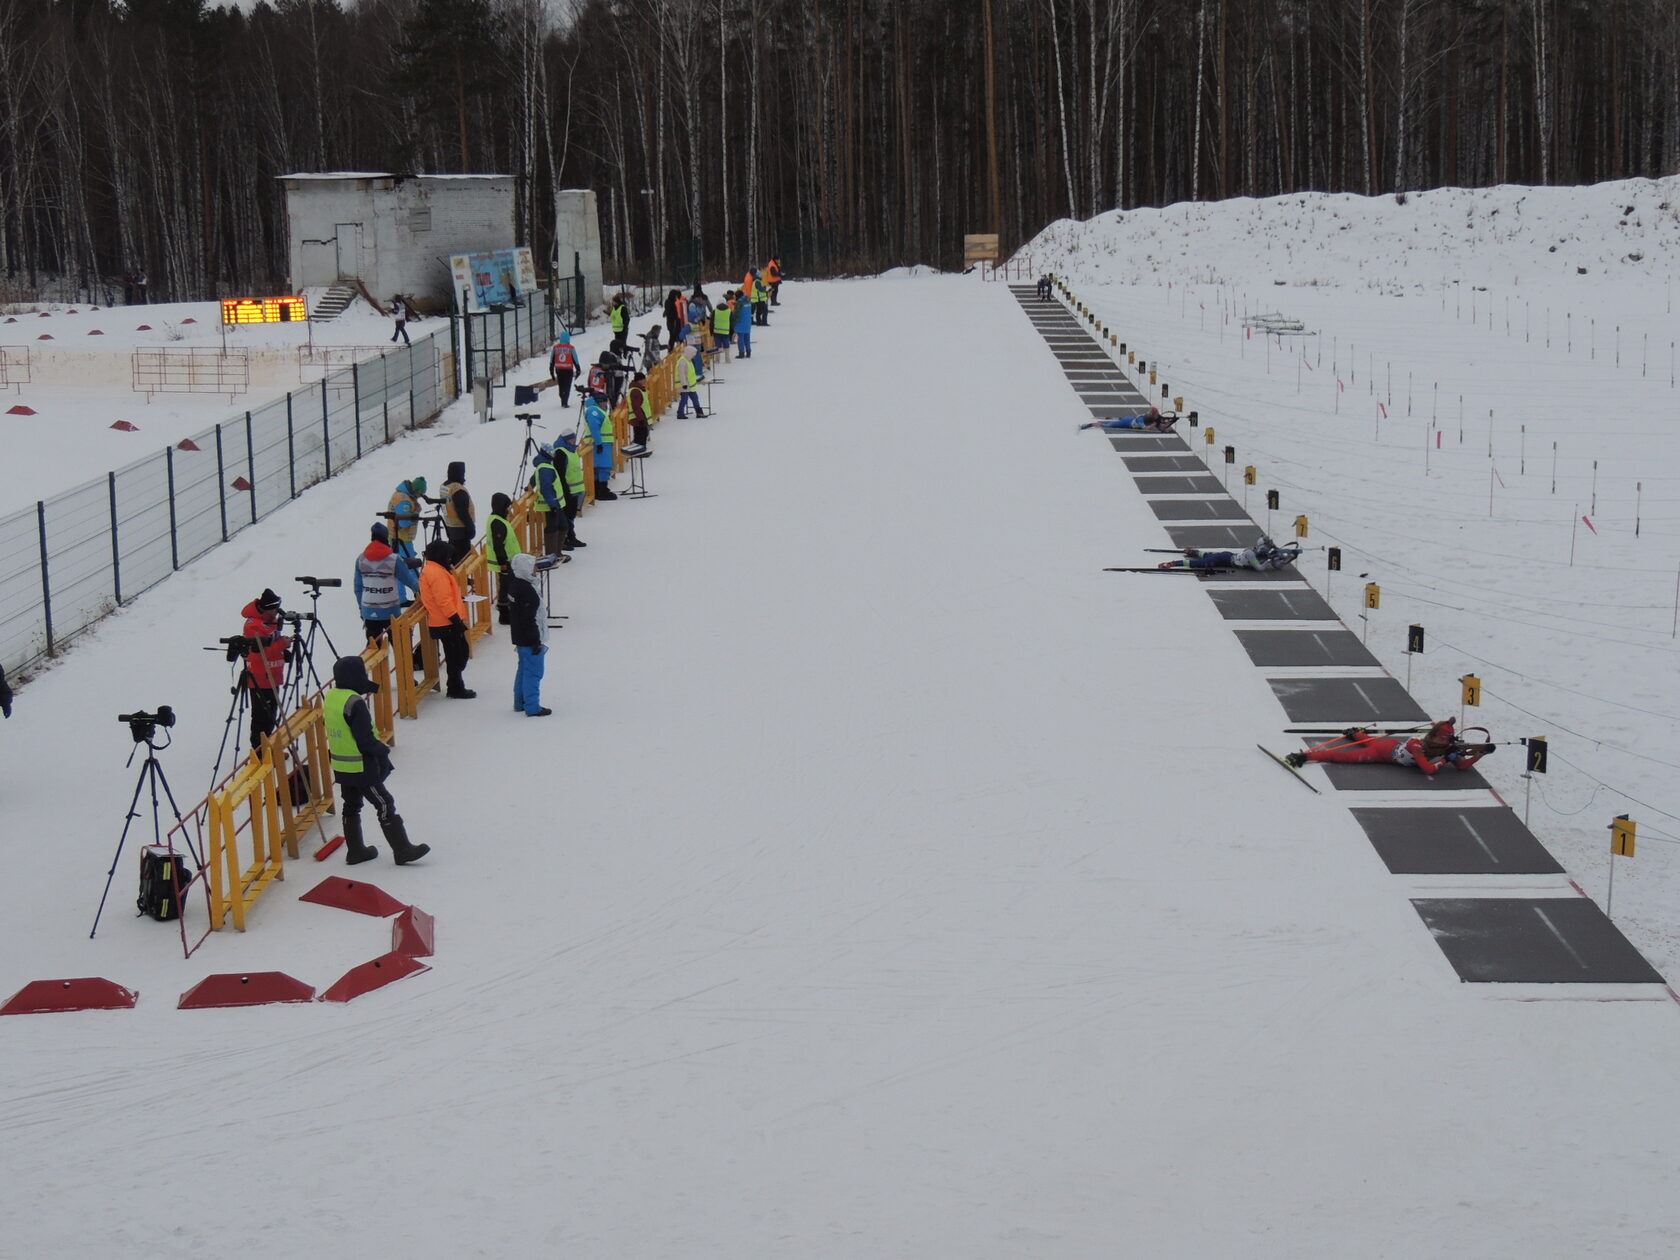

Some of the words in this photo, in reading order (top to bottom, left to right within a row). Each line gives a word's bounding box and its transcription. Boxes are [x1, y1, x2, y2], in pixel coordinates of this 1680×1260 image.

[1332, 556, 1337, 570] 6
[1369, 593, 1376, 609] 5
[1413, 635, 1420, 652] 4
[1467, 687, 1474, 706] 3
[1533, 751, 1542, 772] 2
[1620, 832, 1626, 856] 1
